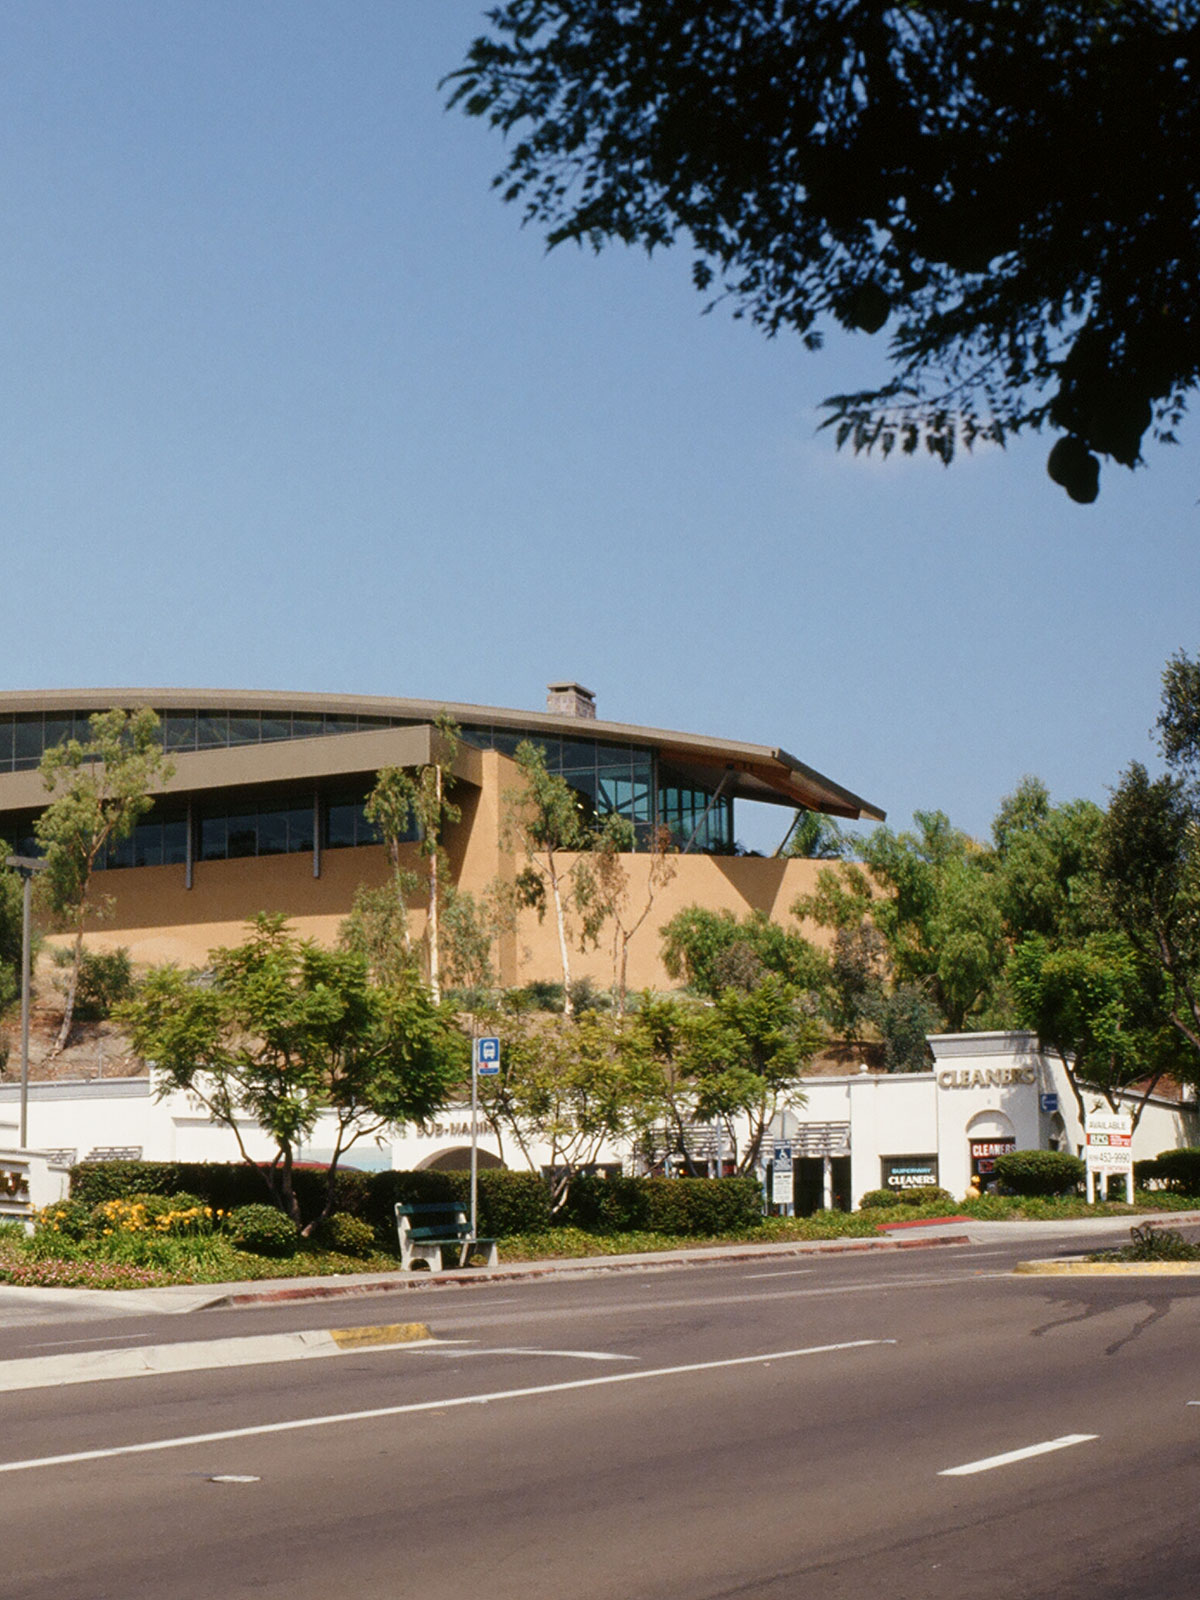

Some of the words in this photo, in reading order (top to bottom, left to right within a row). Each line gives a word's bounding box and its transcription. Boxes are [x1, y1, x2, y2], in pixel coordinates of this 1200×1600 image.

[938, 1067, 1035, 1088] CLEANERS
[973, 1144, 1017, 1157] CLEANERS
[888, 1175, 936, 1186] CLEANERS
